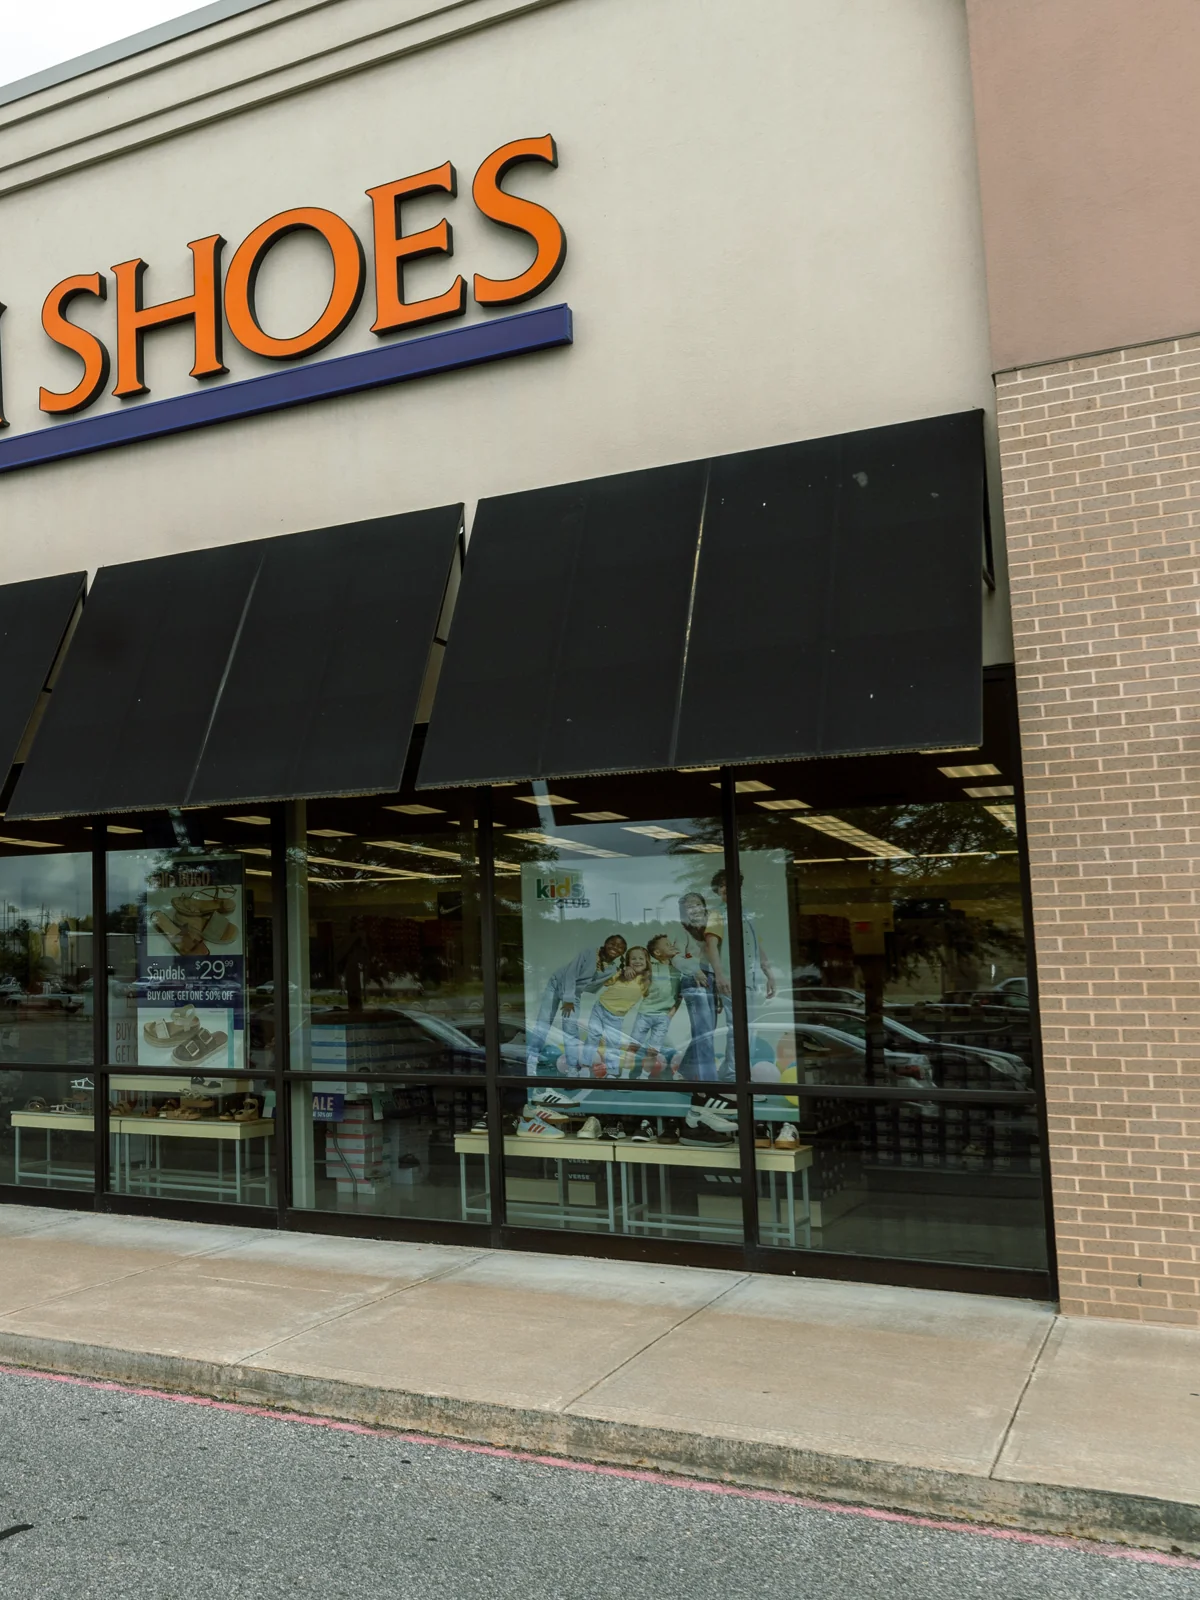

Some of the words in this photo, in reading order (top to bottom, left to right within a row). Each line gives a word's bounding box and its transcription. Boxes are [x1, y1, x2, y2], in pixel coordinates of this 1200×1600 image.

[39, 133, 568, 415] SHOES
[536, 876, 583, 898] kids
[146, 965, 186, 980] Sandals
[147, 990, 161, 1001] BUY
[177, 990, 189, 1001] GET
[189, 990, 203, 1001] ONE
[205, 990, 221, 1001] 50%
[221, 990, 234, 1001] OFF
[116, 1023, 131, 1041] BUY
[116, 1045, 131, 1063] GET
[312, 1096, 334, 1111] ALE
